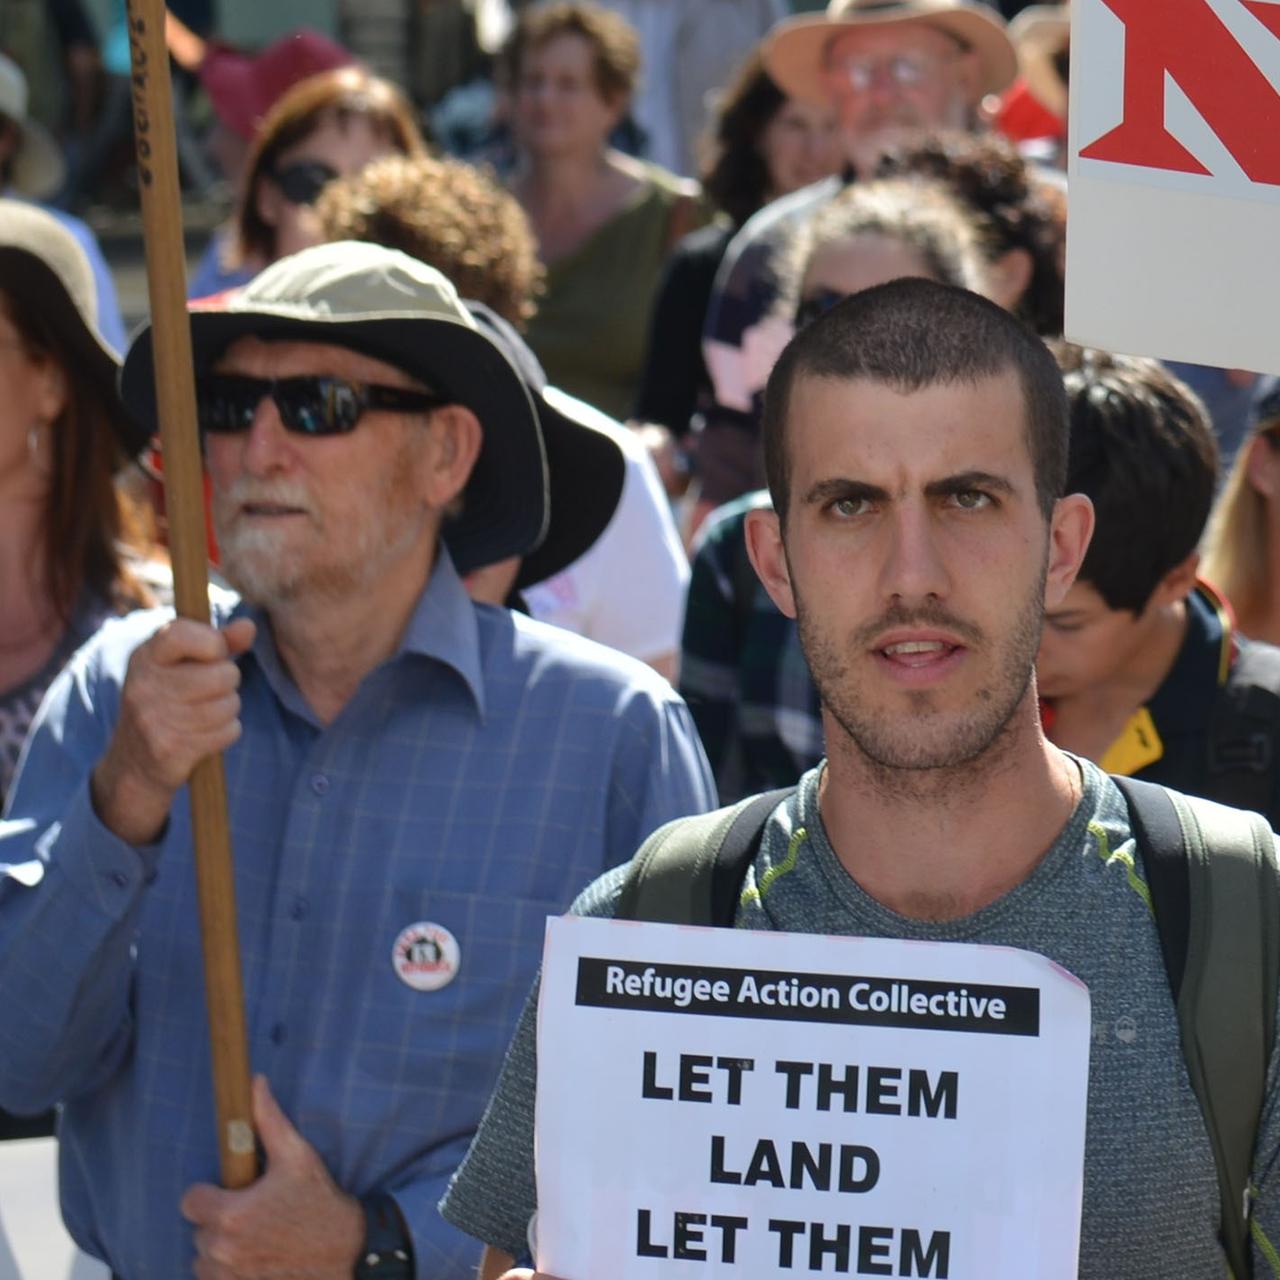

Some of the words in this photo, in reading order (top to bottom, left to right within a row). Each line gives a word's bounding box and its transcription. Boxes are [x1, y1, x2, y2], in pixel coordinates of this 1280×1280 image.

[605, 966, 730, 1007] Refugee
[737, 975, 840, 1010] Action
[848, 983, 1007, 1020] Collective
[641, 1051, 754, 1106] LET
[775, 1060, 960, 1120] THEM
[709, 1135, 881, 1193] LAND
[637, 1208, 749, 1264] LET
[768, 1218, 951, 1279] THEM
